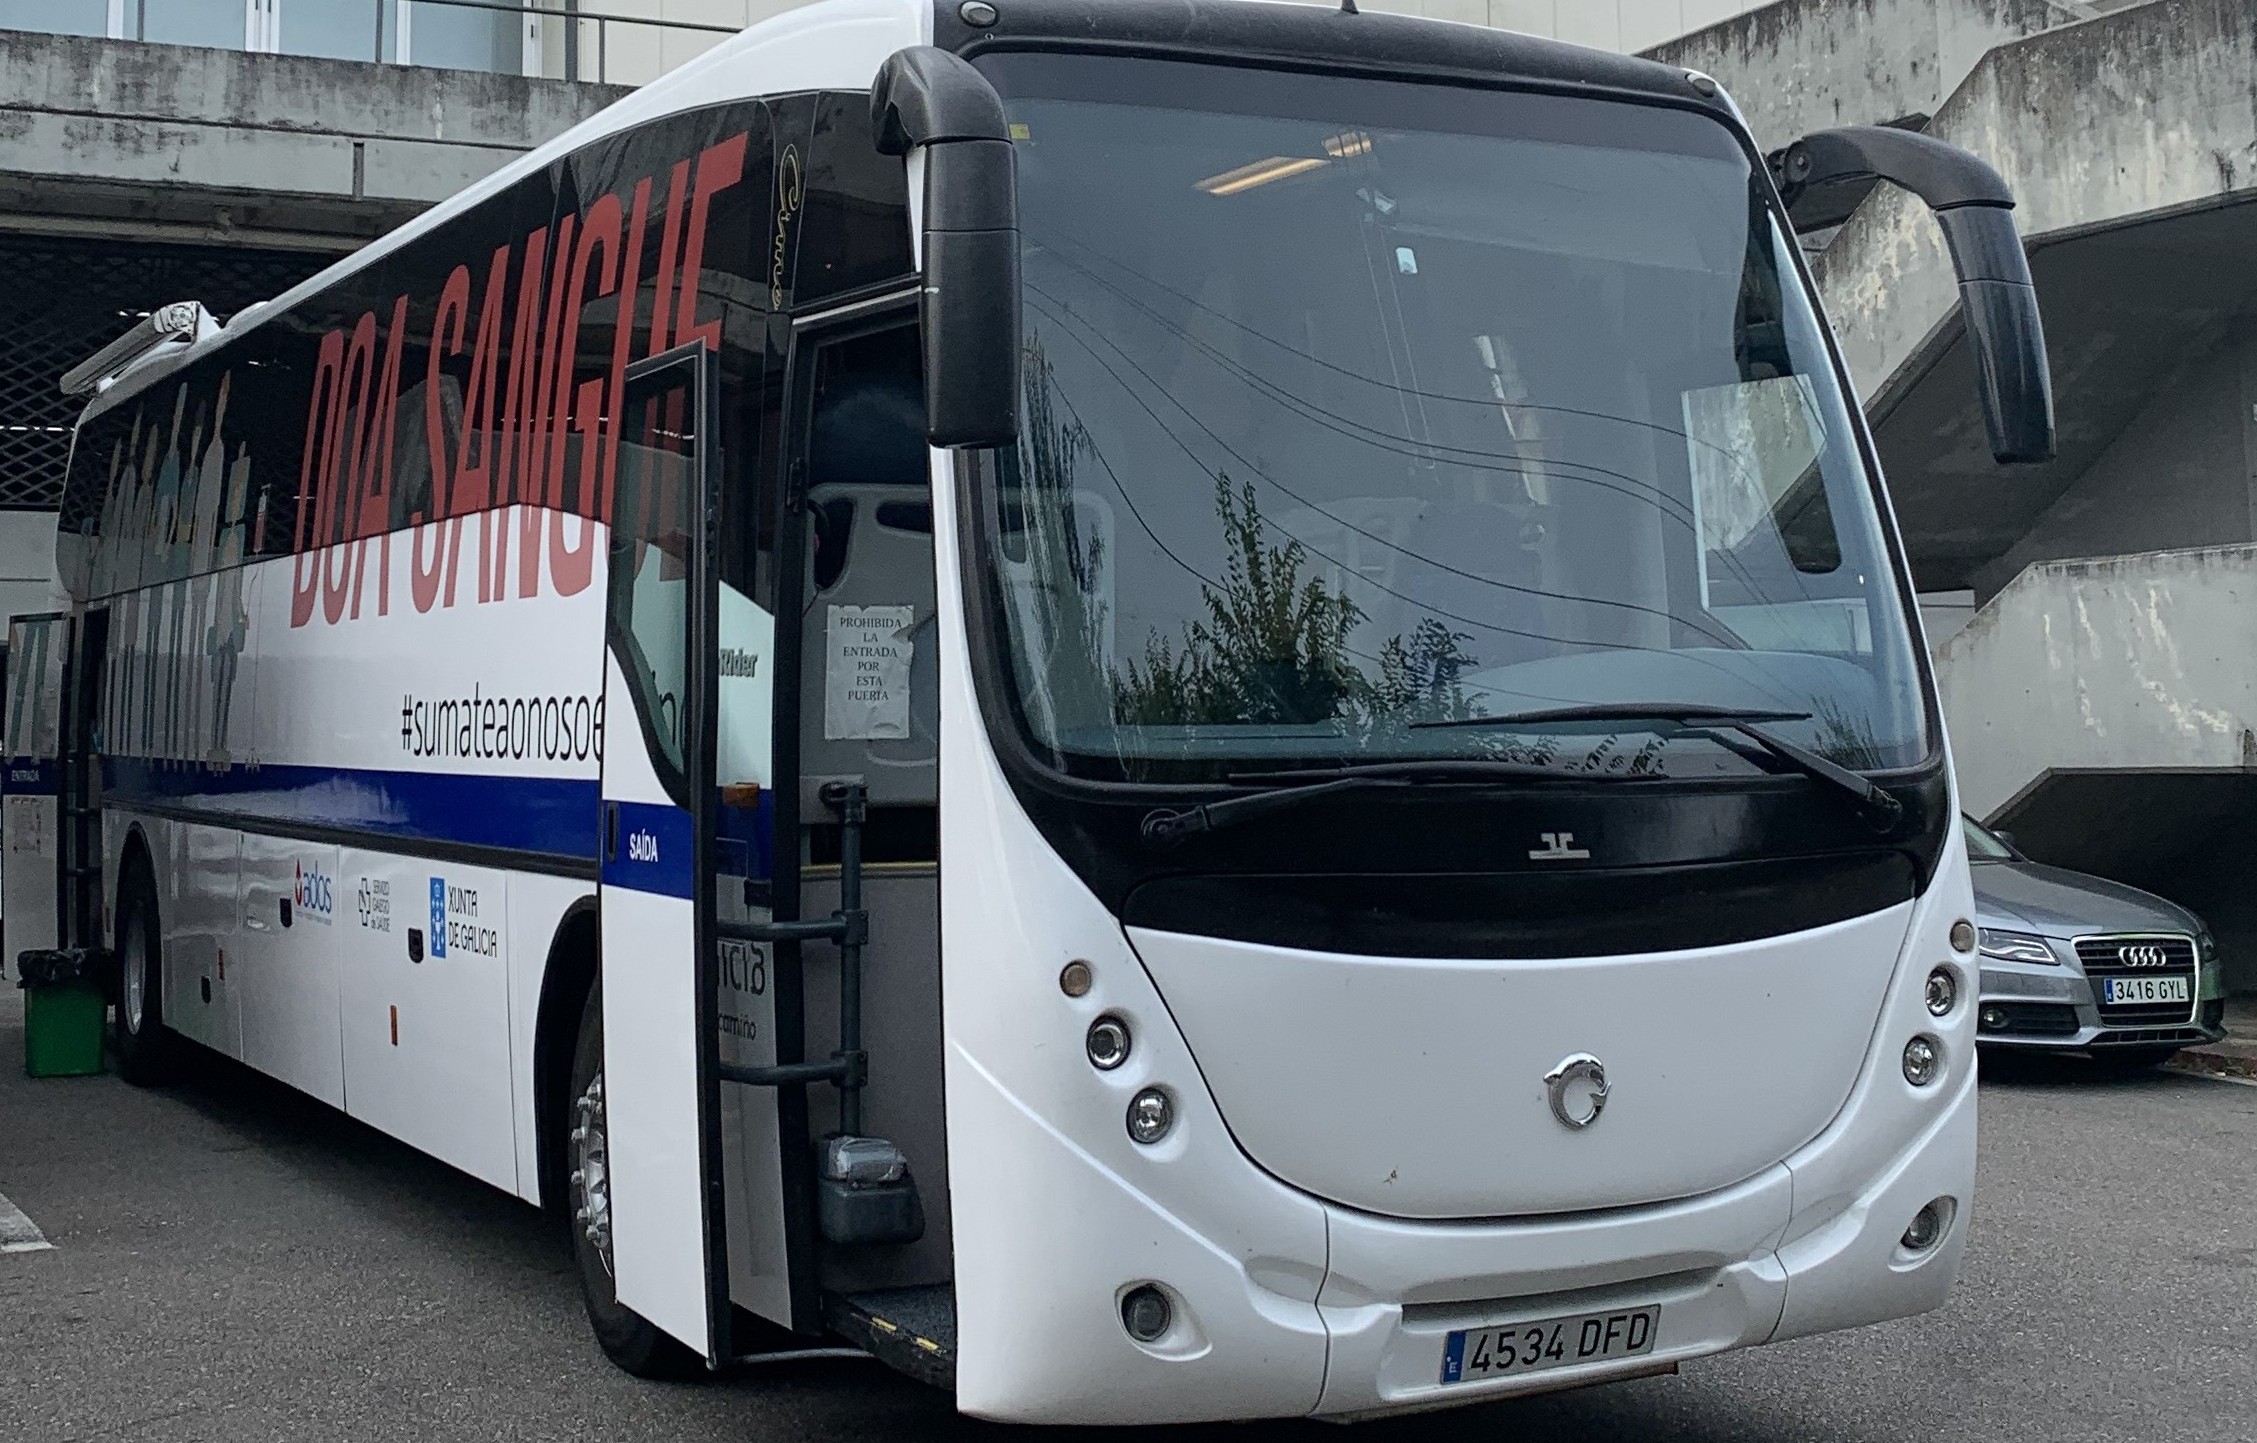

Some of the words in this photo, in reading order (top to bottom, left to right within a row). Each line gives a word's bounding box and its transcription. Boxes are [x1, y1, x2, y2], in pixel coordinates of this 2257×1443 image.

[291, 294, 408, 628] DOA
[411, 131, 748, 614] SANGUE
[840, 617, 902, 628] PROHIBIDA
[863, 632, 878, 642] LA
[843, 647, 898, 657] ENTRADA
[858, 661, 879, 671] POR
[856, 676, 883, 686] ESTA
[848, 690, 889, 700] PUERTA
[402, 681, 686, 763] #sumateaonosoe
[629, 828, 659, 862] SAÍDA
[303, 860, 332, 914] ados
[448, 886, 478, 917] XUNTA
[448, 921, 460, 948] DE
[461, 924, 498, 958] GALICIA
[2116, 981, 2154, 1000] 3416
[2159, 981, 2185, 999] GYL
[1470, 1323, 1564, 1372] 4534
[1578, 1312, 1650, 1357] DFD
